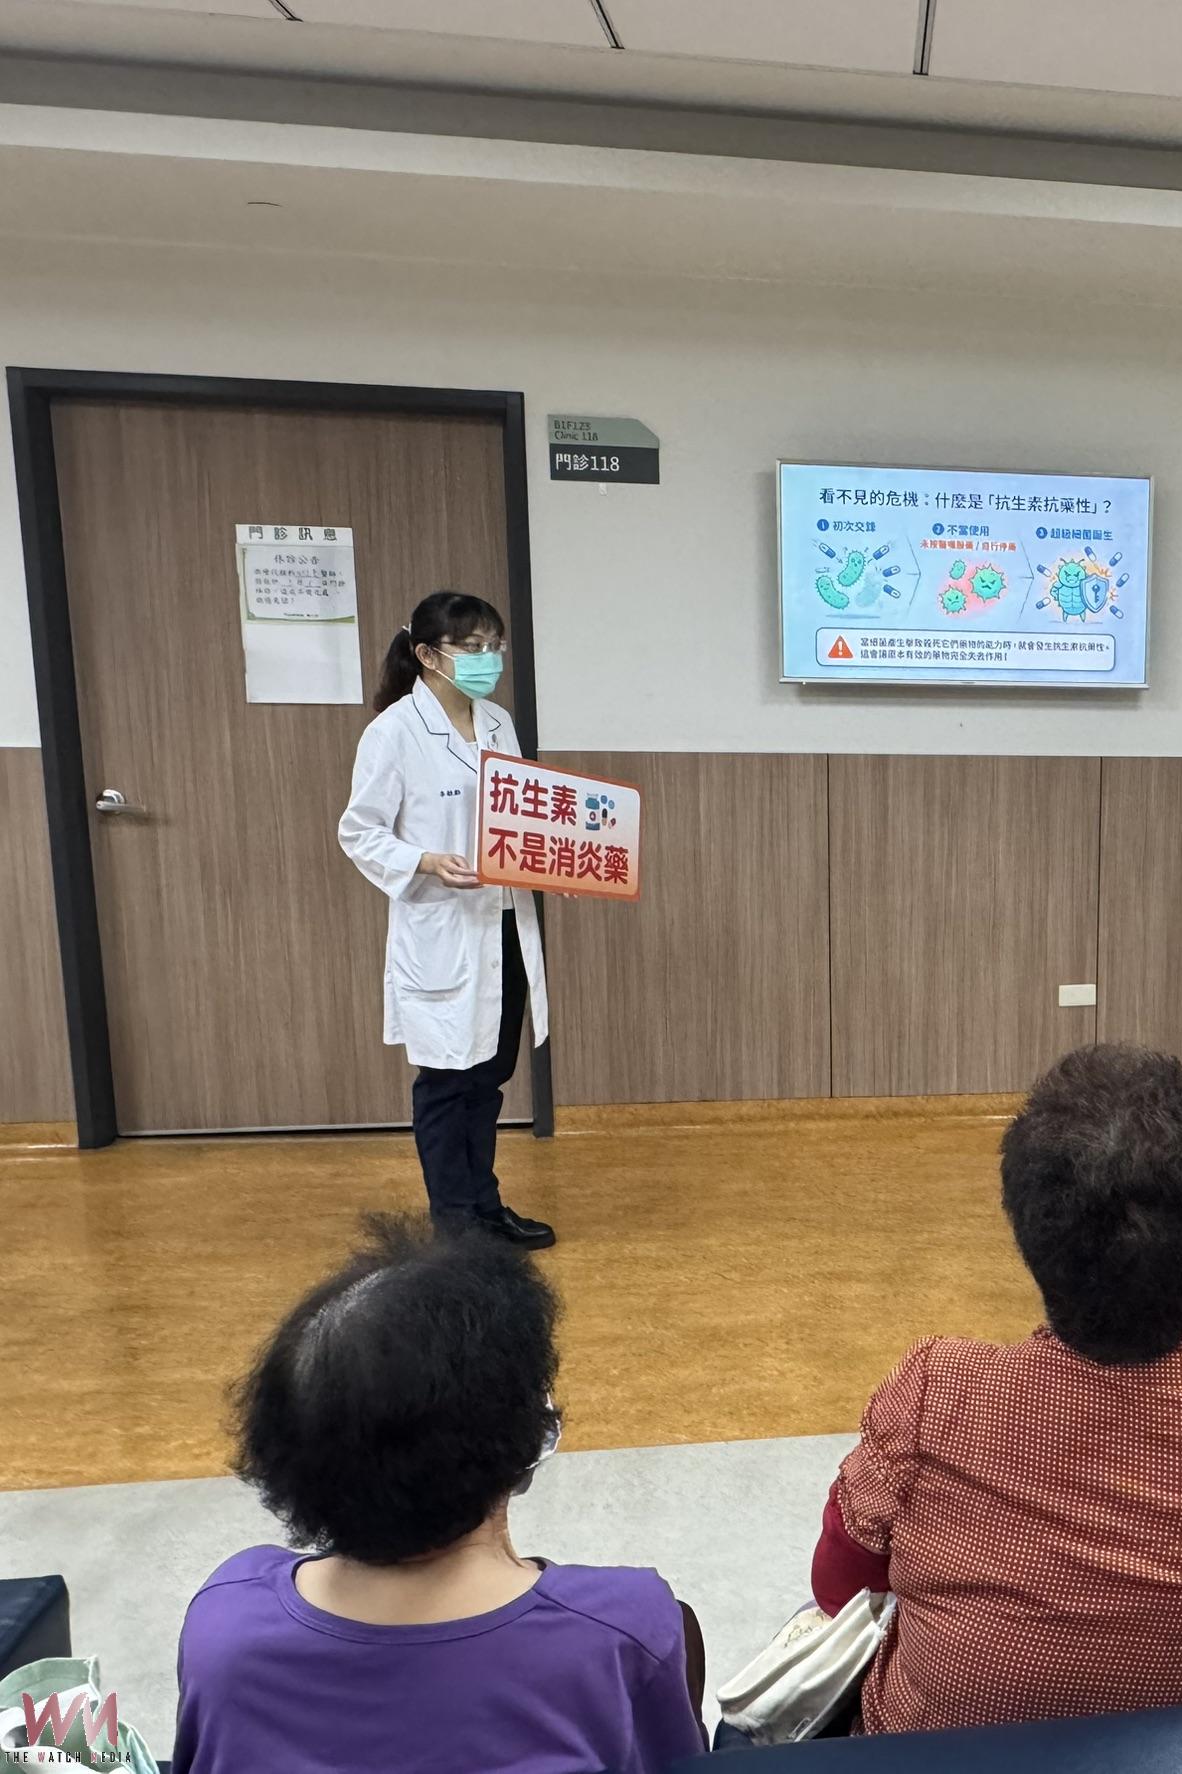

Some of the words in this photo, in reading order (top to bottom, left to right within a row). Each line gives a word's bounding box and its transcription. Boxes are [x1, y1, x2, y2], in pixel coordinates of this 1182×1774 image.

[555, 453, 620, 472] 門診118
[490, 770, 577, 826] 抗生素
[488, 827, 629, 884] 不是消炎藥
